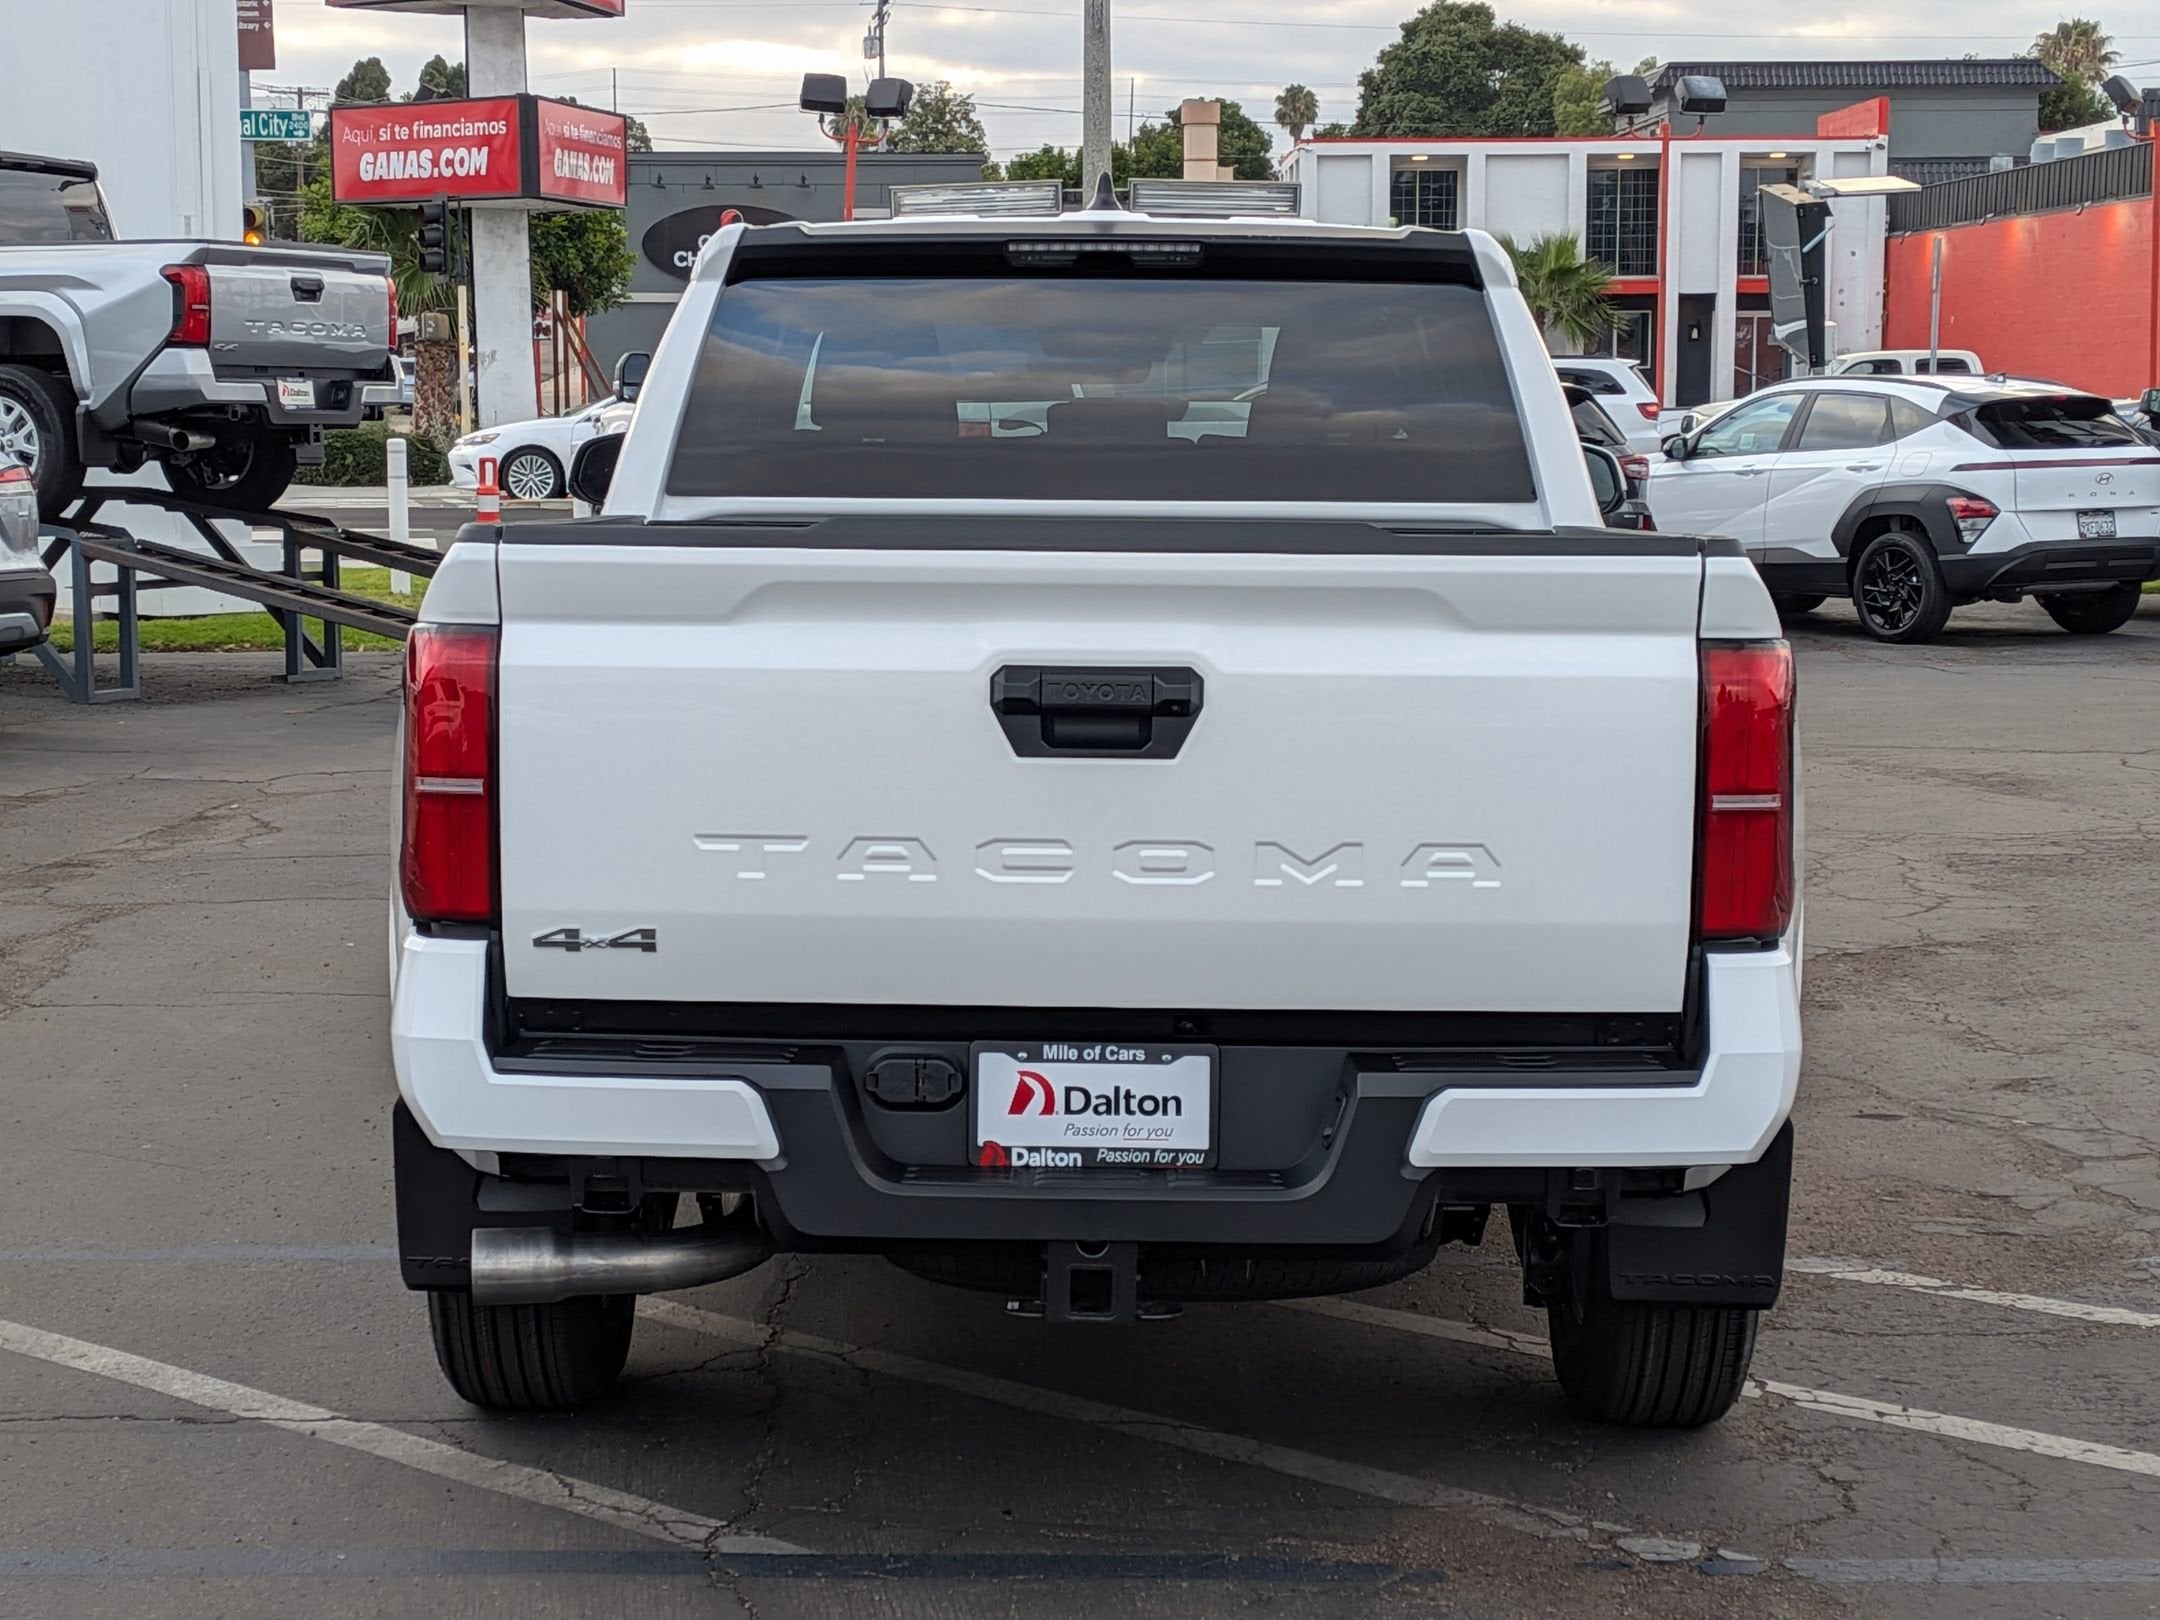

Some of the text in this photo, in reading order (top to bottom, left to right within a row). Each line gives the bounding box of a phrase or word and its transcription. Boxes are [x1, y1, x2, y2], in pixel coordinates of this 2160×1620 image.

[258, 112, 288, 138] City
[342, 117, 507, 146] Aquí, sí te financiamos
[359, 146, 489, 182] GANAS.COM
[553, 147, 615, 185] GANAS.COM
[244, 319, 367, 339] TACOMA
[1046, 682, 1148, 701] TOYOTA
[692, 832, 1502, 888] TACOMA
[1042, 1044, 1146, 1062] Mile of Cars
[1063, 1085, 1183, 1118] Dalton
[1063, 1122, 1175, 1140] Passion for you
[1010, 1146, 1206, 1168] Dalton Passion for you
